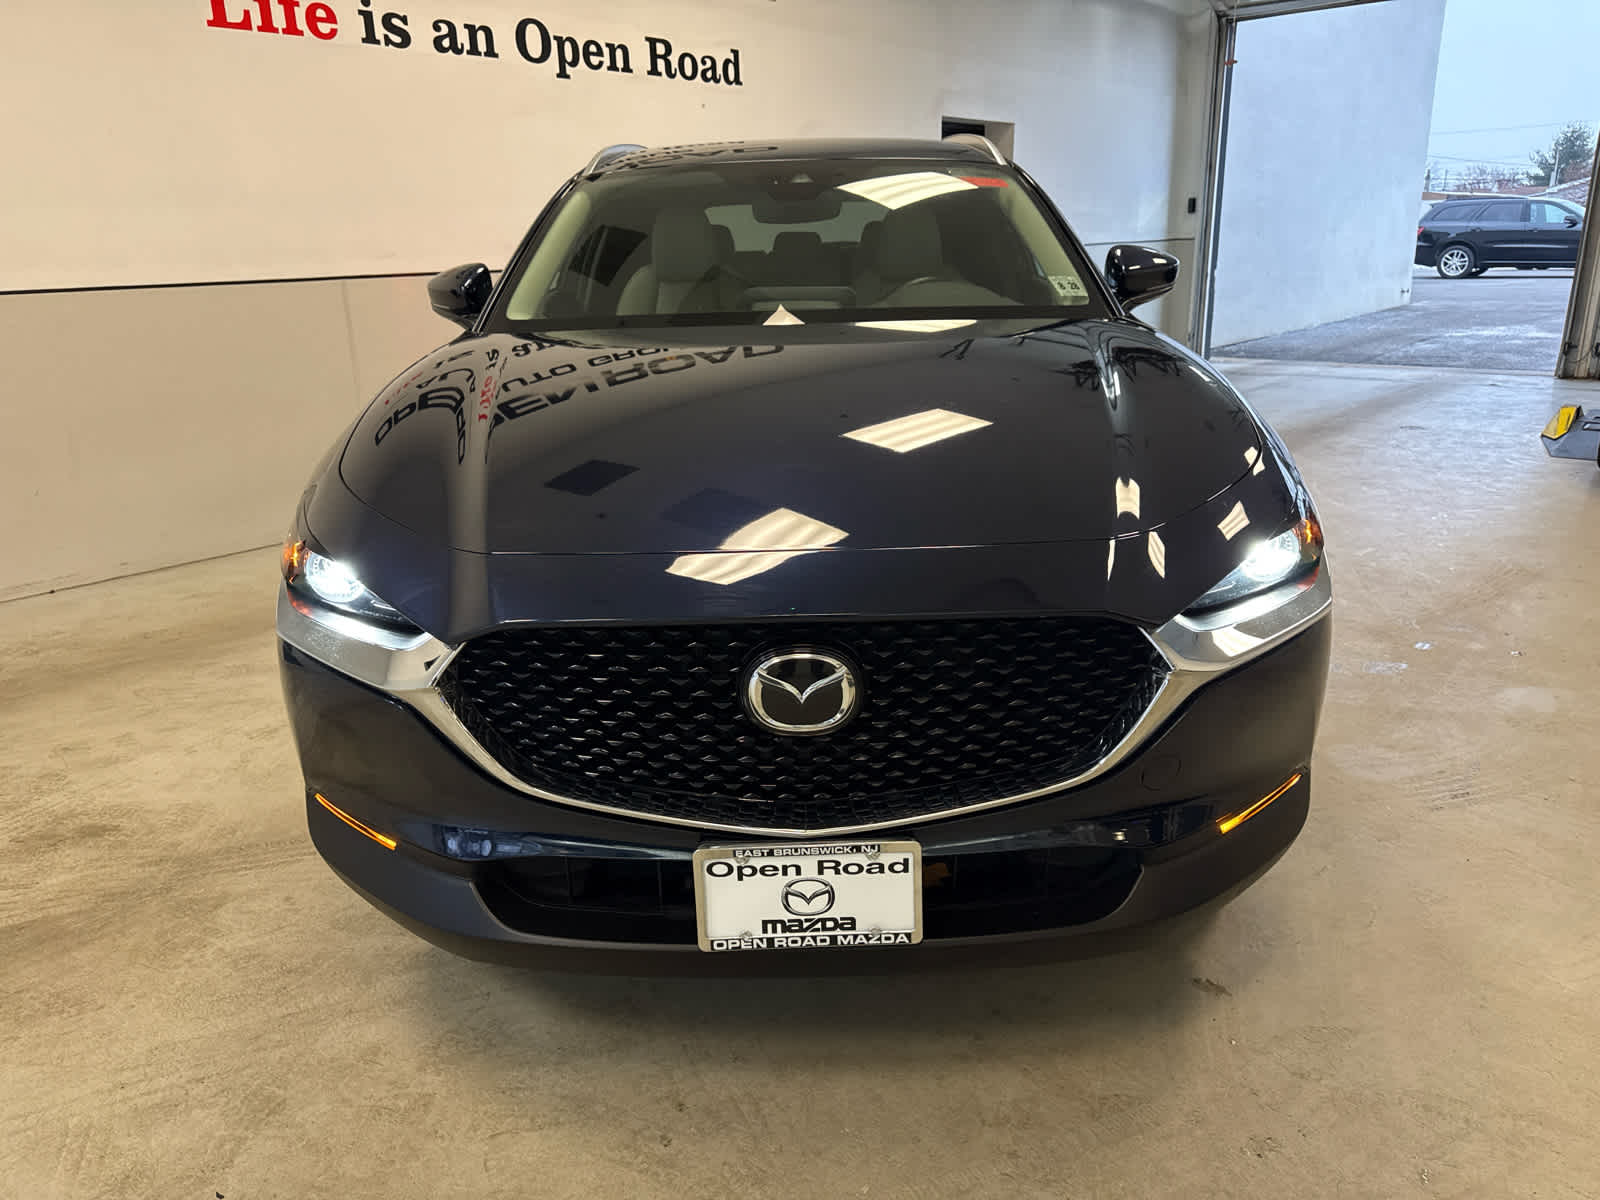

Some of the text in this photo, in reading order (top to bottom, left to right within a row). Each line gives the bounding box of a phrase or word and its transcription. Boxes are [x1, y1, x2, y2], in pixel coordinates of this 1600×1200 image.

[357, 0, 412, 49] is
[432, 18, 499, 58] an
[515, 17, 633, 80] Open
[644, 36, 743, 86] Road
[735, 849, 769, 857] EAST
[861, 844, 879, 854] NJ
[706, 858, 910, 881] Open Road
[761, 916, 857, 935] mazda
[713, 932, 910, 950] OPEN ROAD MAZDA
